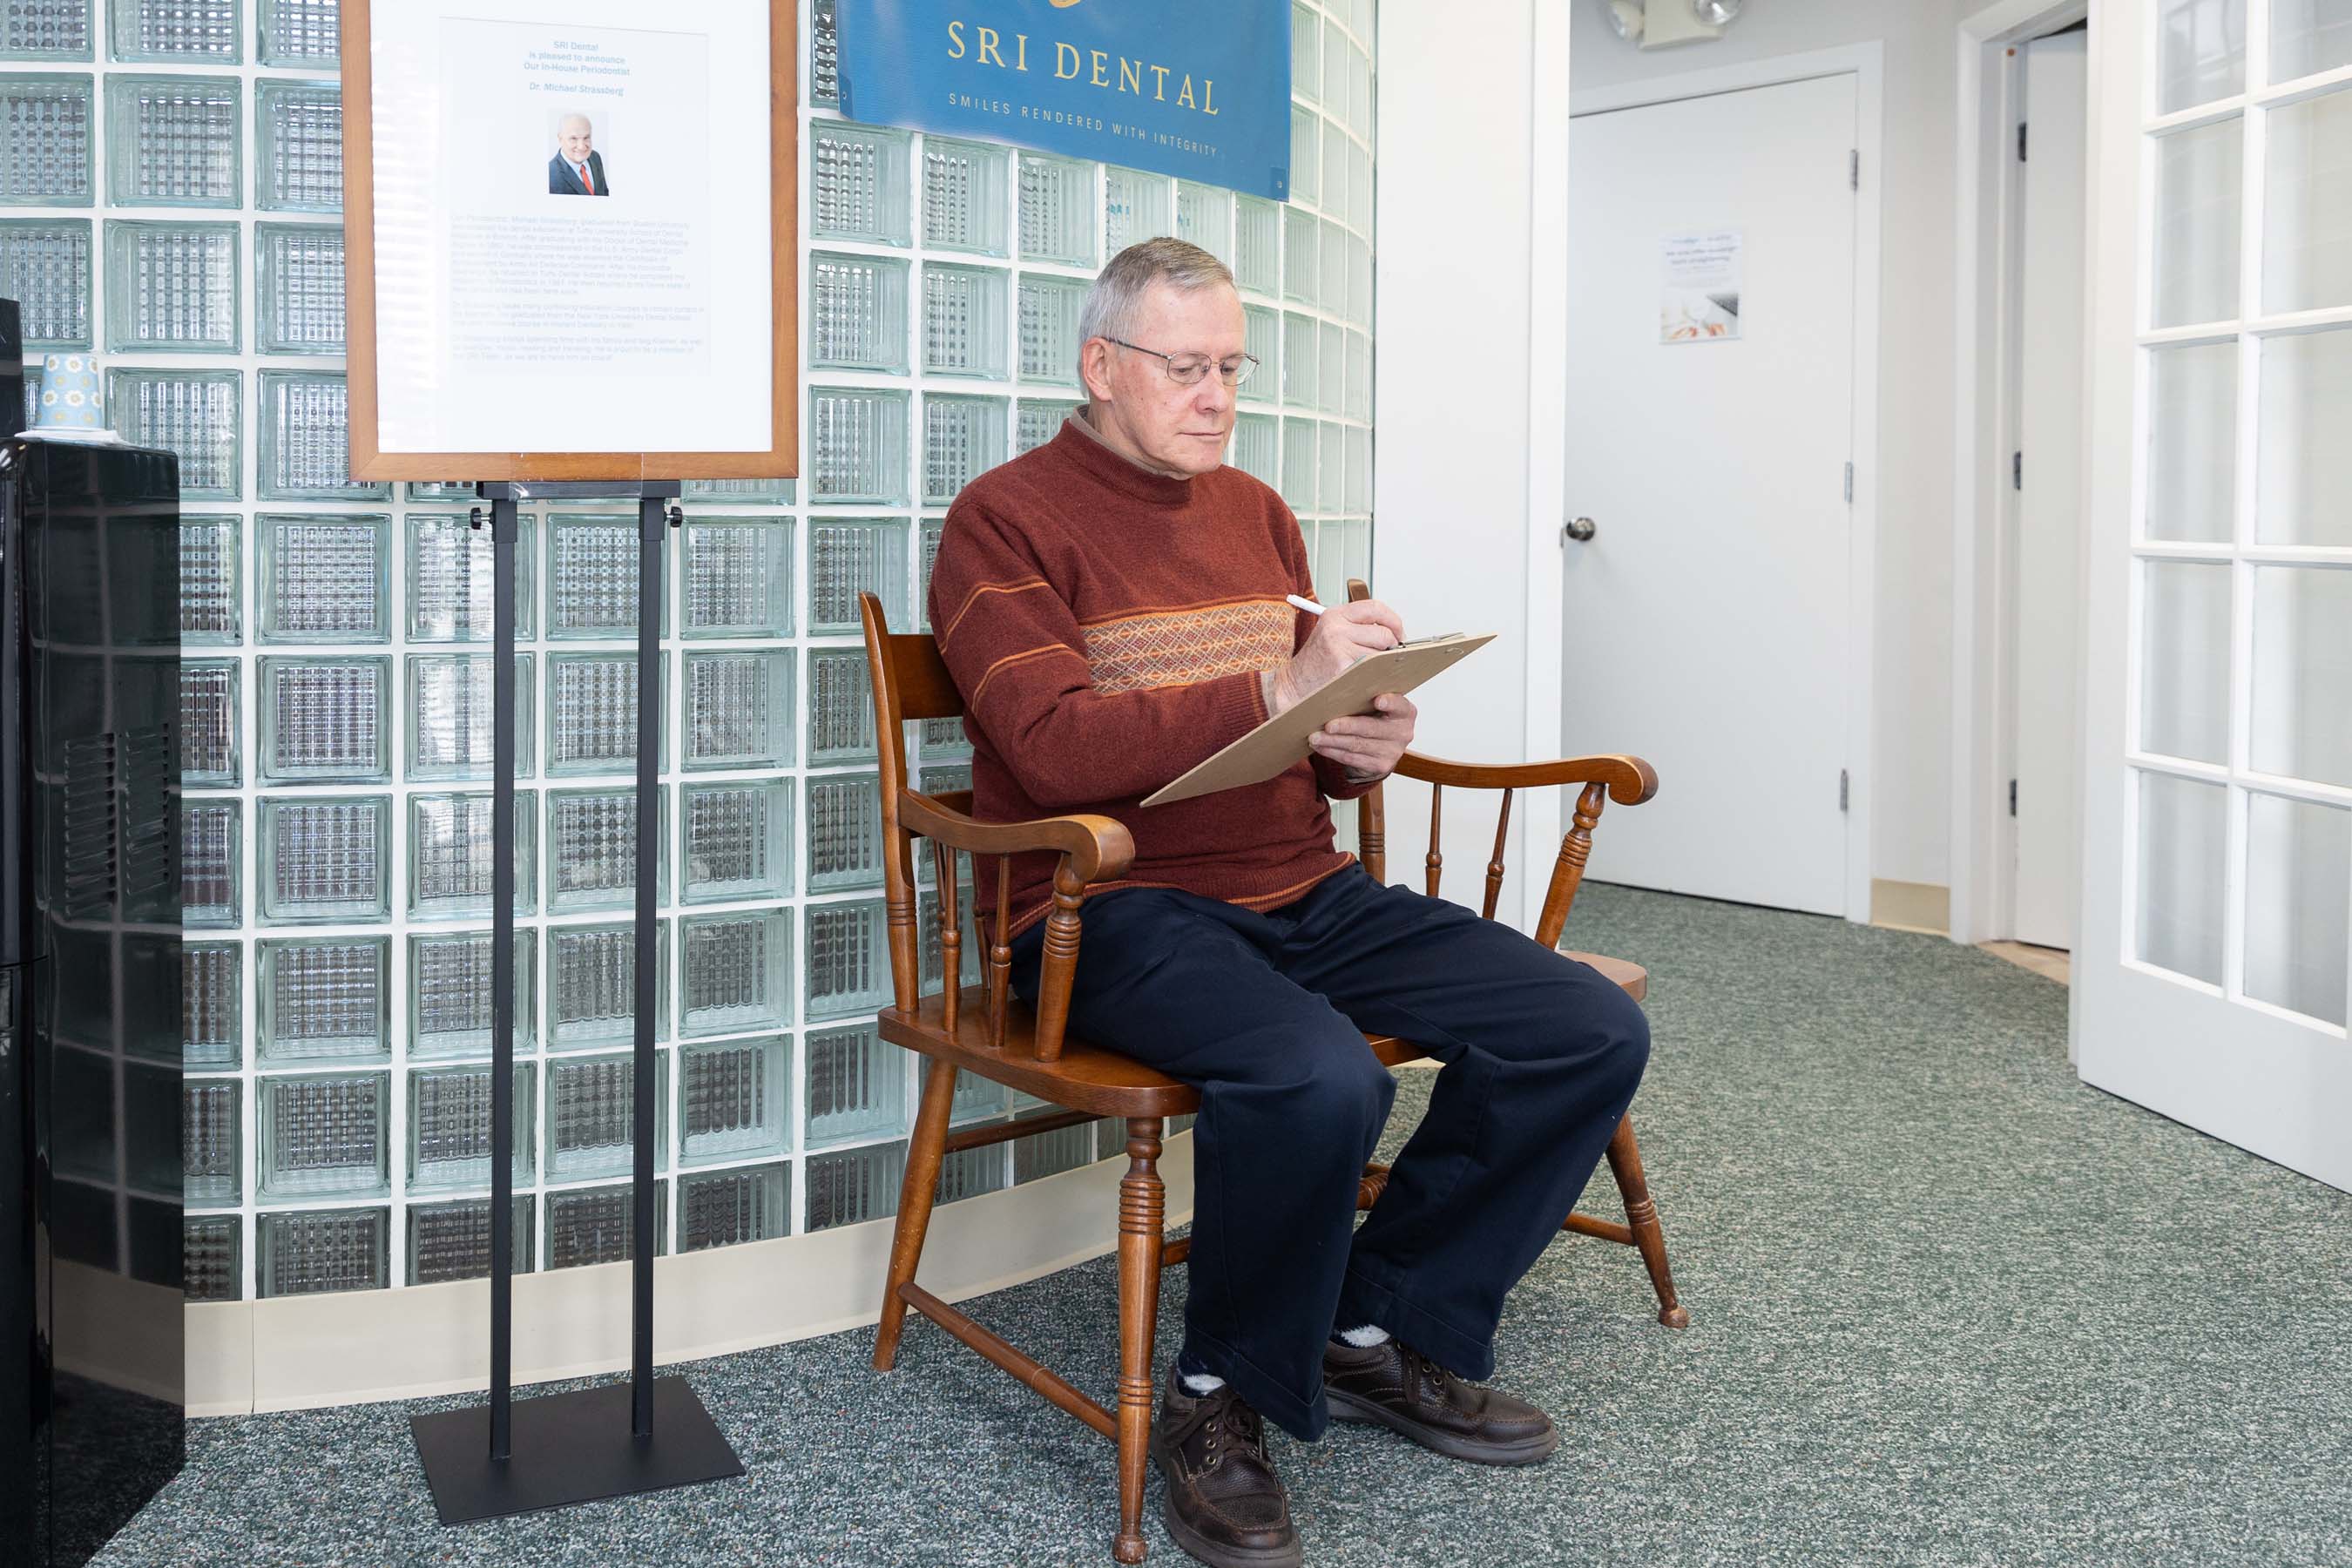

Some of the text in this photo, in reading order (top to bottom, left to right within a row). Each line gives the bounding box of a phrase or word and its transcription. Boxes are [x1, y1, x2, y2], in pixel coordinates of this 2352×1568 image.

[553, 41, 599, 51] SRI Dental
[538, 51, 572, 62] pleased
[573, 53, 583, 62] to
[585, 55, 625, 64] announce
[524, 62, 631, 76] Our In-House Periodontist
[948, 21, 1220, 116] SRI DENTAL
[529, 82, 625, 98] Dr. Michael Strassberg
[949, 92, 1217, 158] SMILES RENDERED WITH INTEGRITY
